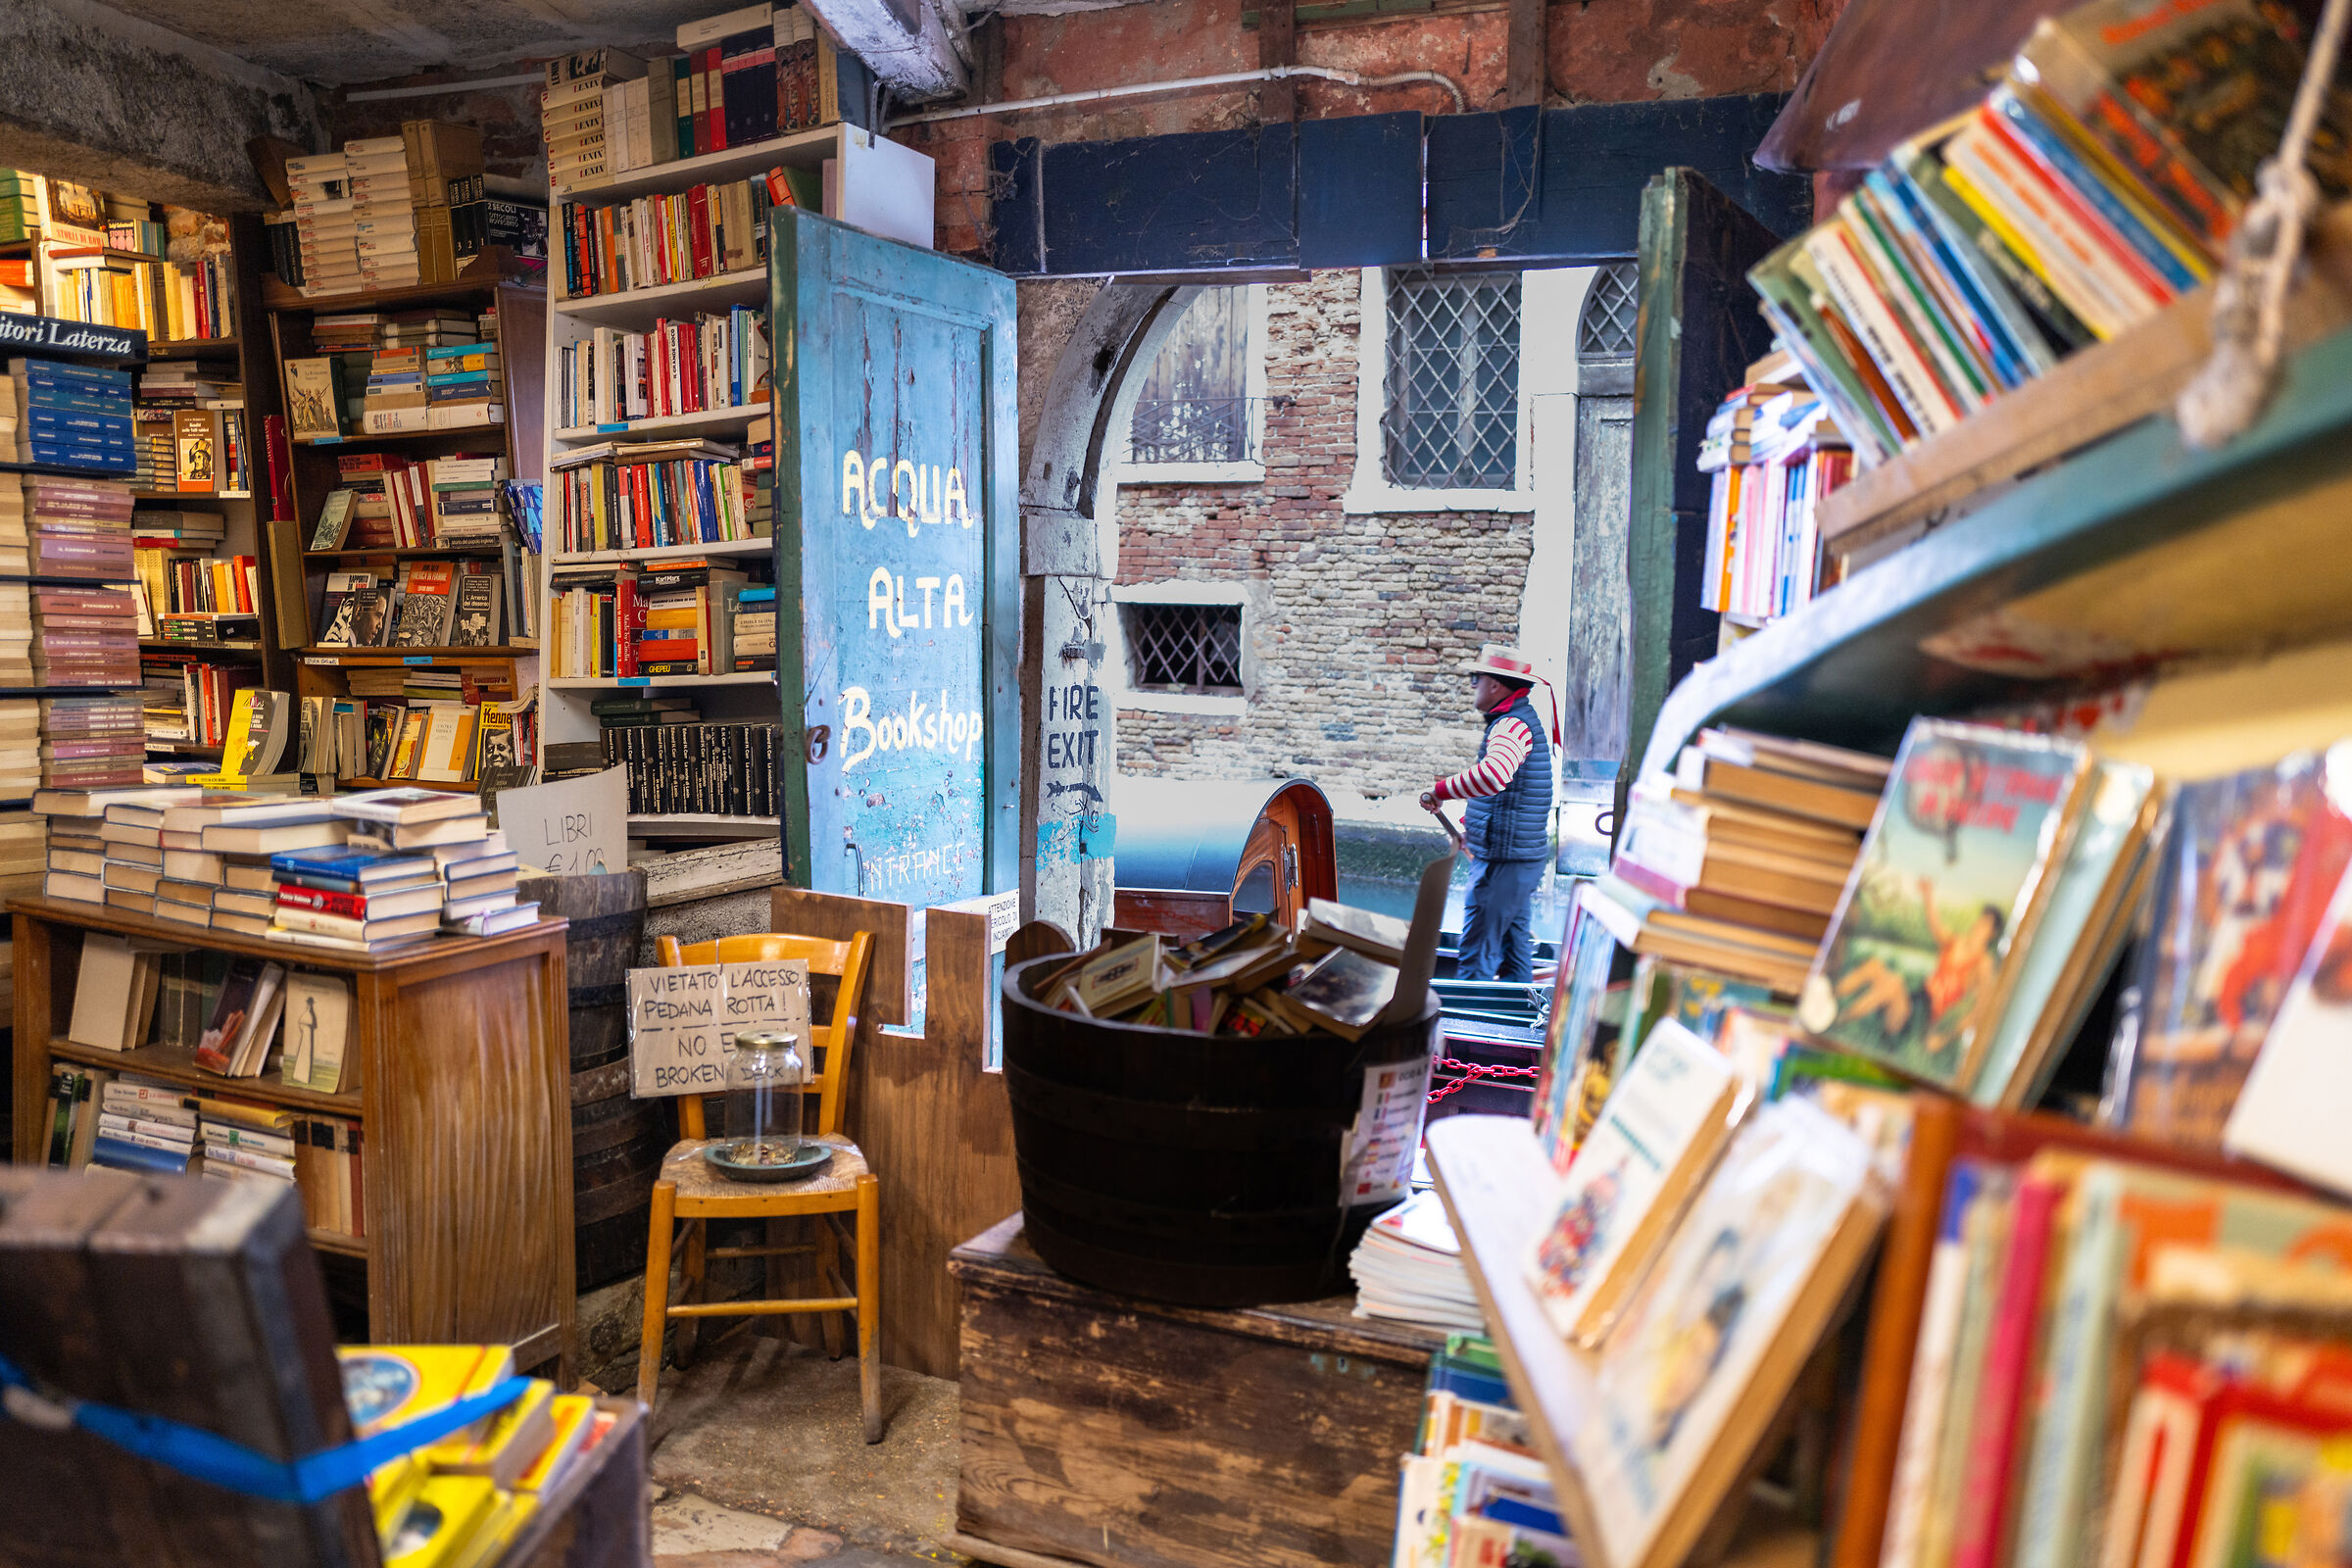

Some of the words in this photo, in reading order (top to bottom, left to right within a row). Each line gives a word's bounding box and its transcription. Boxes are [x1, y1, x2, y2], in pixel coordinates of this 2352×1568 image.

[551, 61, 561, 85] LENIN
[492, 204, 517, 214] SECOLI
[457, 241, 463, 252] 3
[466, 239, 472, 250] 2
[49, 322, 132, 355] Laterza
[842, 450, 974, 539] ACQUA
[868, 566, 974, 639] ALTA
[649, 664, 671, 674] GHEPEU
[1049, 684, 1100, 721] FIRE
[483, 708, 513, 724] Kenne
[838, 686, 983, 772] Bookshop
[1047, 729, 1100, 768] EXIT
[544, 812, 592, 847] LIBRI
[868, 842, 965, 892] NTRANCE
[988, 898, 1016, 914] ATTENZIONE
[990, 913, 1011, 929] ERICOLO
[649, 970, 718, 994] VIETATO
[644, 999, 713, 1020] PEDANA
[725, 996, 775, 1015] ROTTA
[678, 1035, 708, 1058] NO
[655, 1062, 724, 1088] BROKEN
